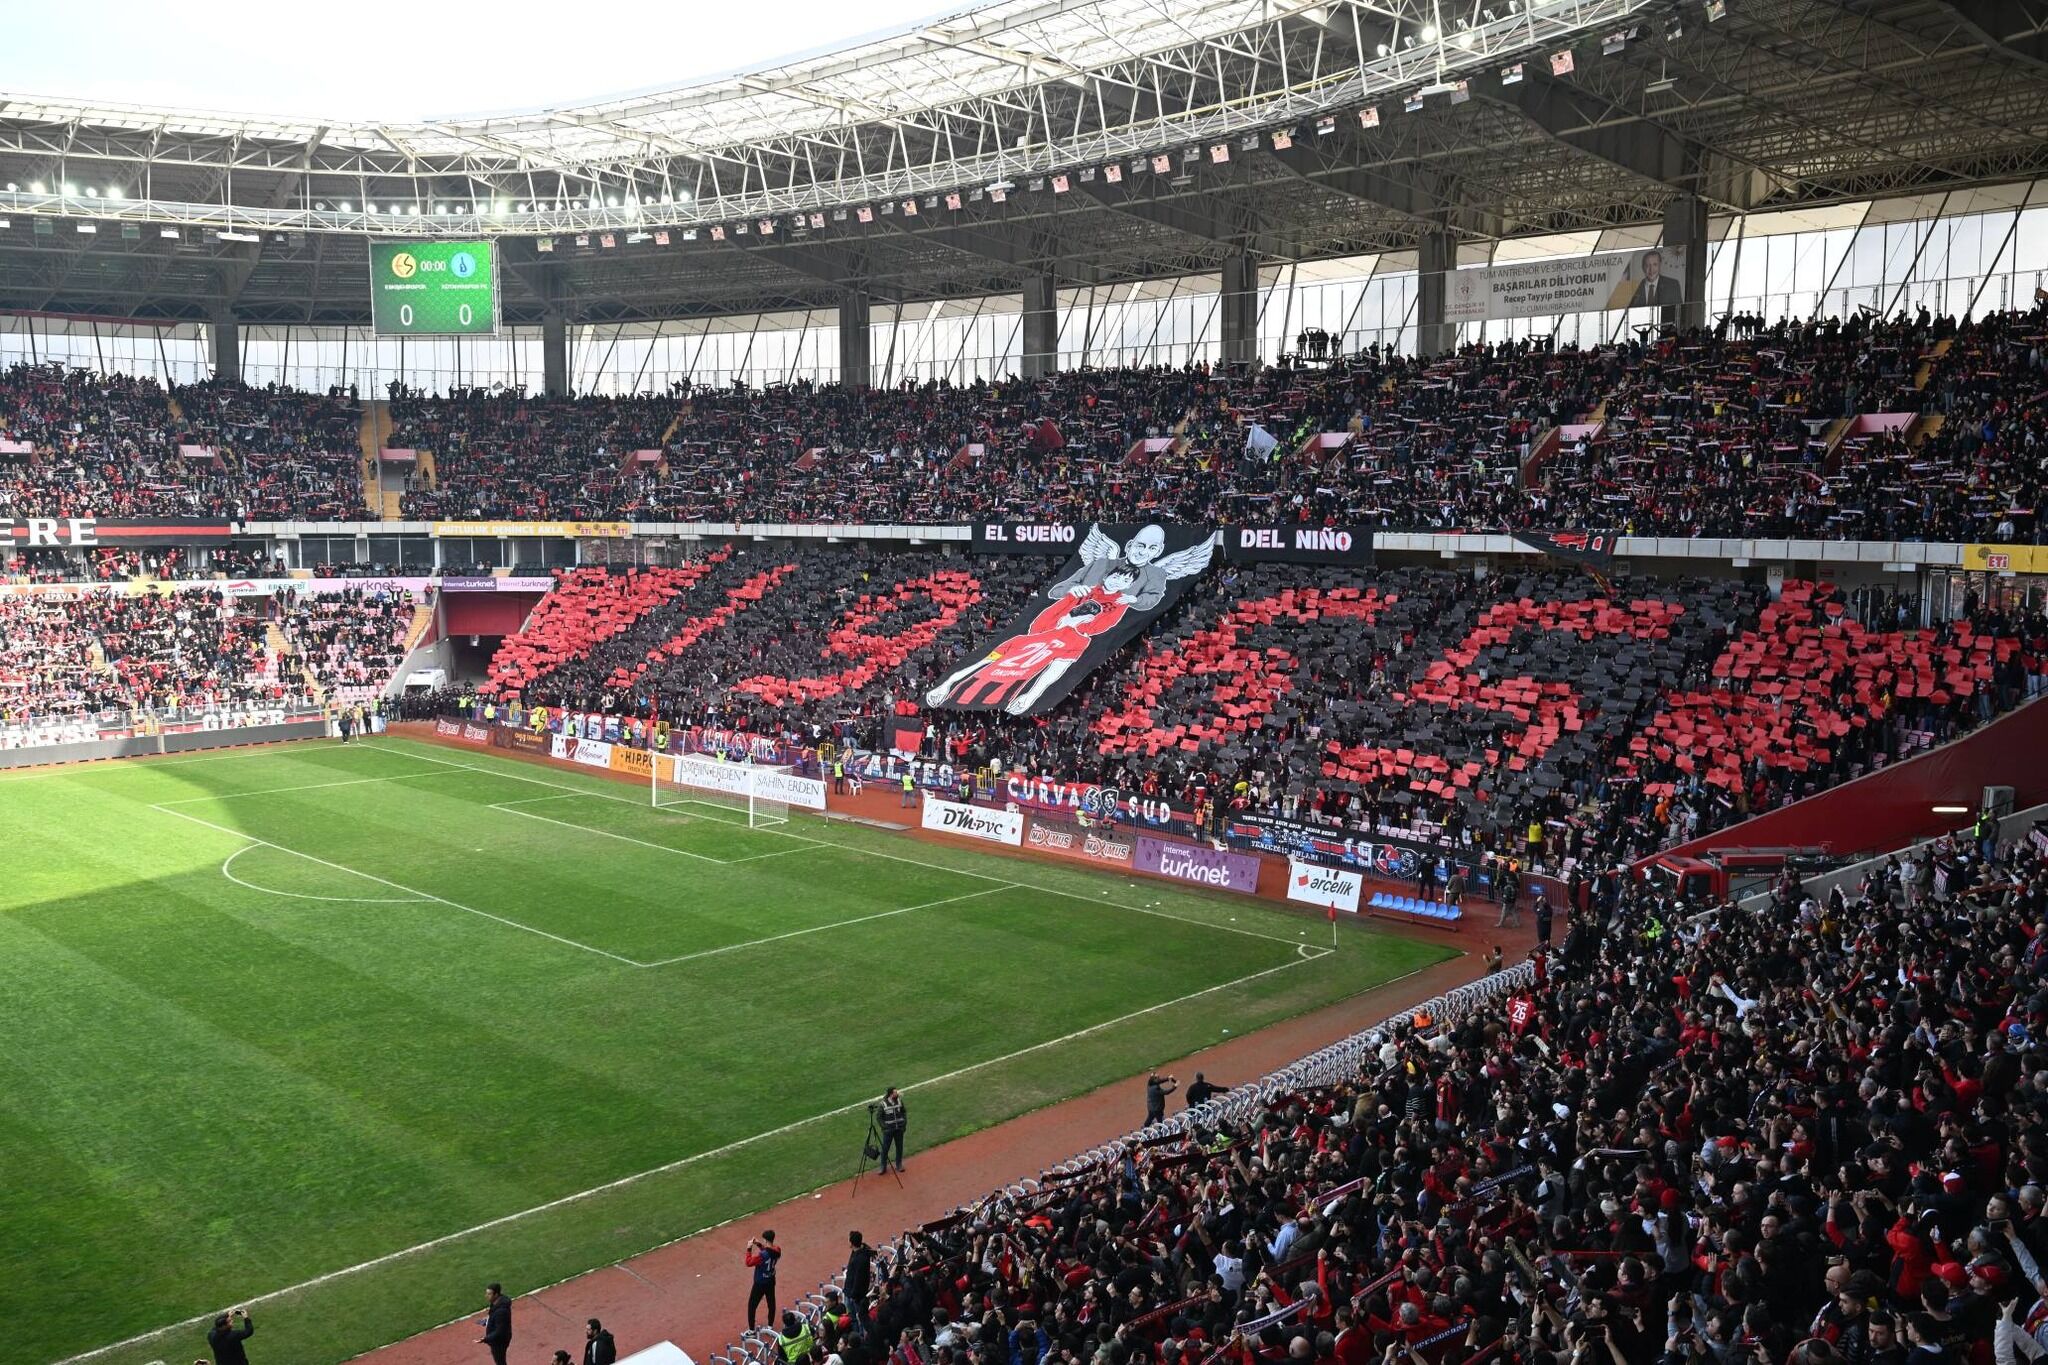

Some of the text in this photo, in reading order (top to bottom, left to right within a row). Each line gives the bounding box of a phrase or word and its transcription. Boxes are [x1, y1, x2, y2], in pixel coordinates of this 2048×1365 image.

[420, 261, 446, 271] 00:00
[1493, 272, 1607, 294] BAŞARILAR DİLİYORUM
[1504, 287, 1595, 304] Recep Tayyip ERDOĞAN
[400, 304, 414, 326] 0
[459, 303, 473, 326] 0
[985, 521, 1076, 542] EL SUEÑO
[1240, 527, 1353, 551] DEL NIÑO
[466, 580, 495, 588] turknet
[788, 779, 819, 796] ERDEN
[1007, 777, 1171, 824] CURVA SUD
[1030, 825, 1072, 848] MAXIMUS
[1086, 836, 1129, 860] MAXIMUS
[1160, 854, 1231, 887] turknet
[1310, 876, 1353, 897] arçelik
[1512, 1004, 1527, 1020] 26
